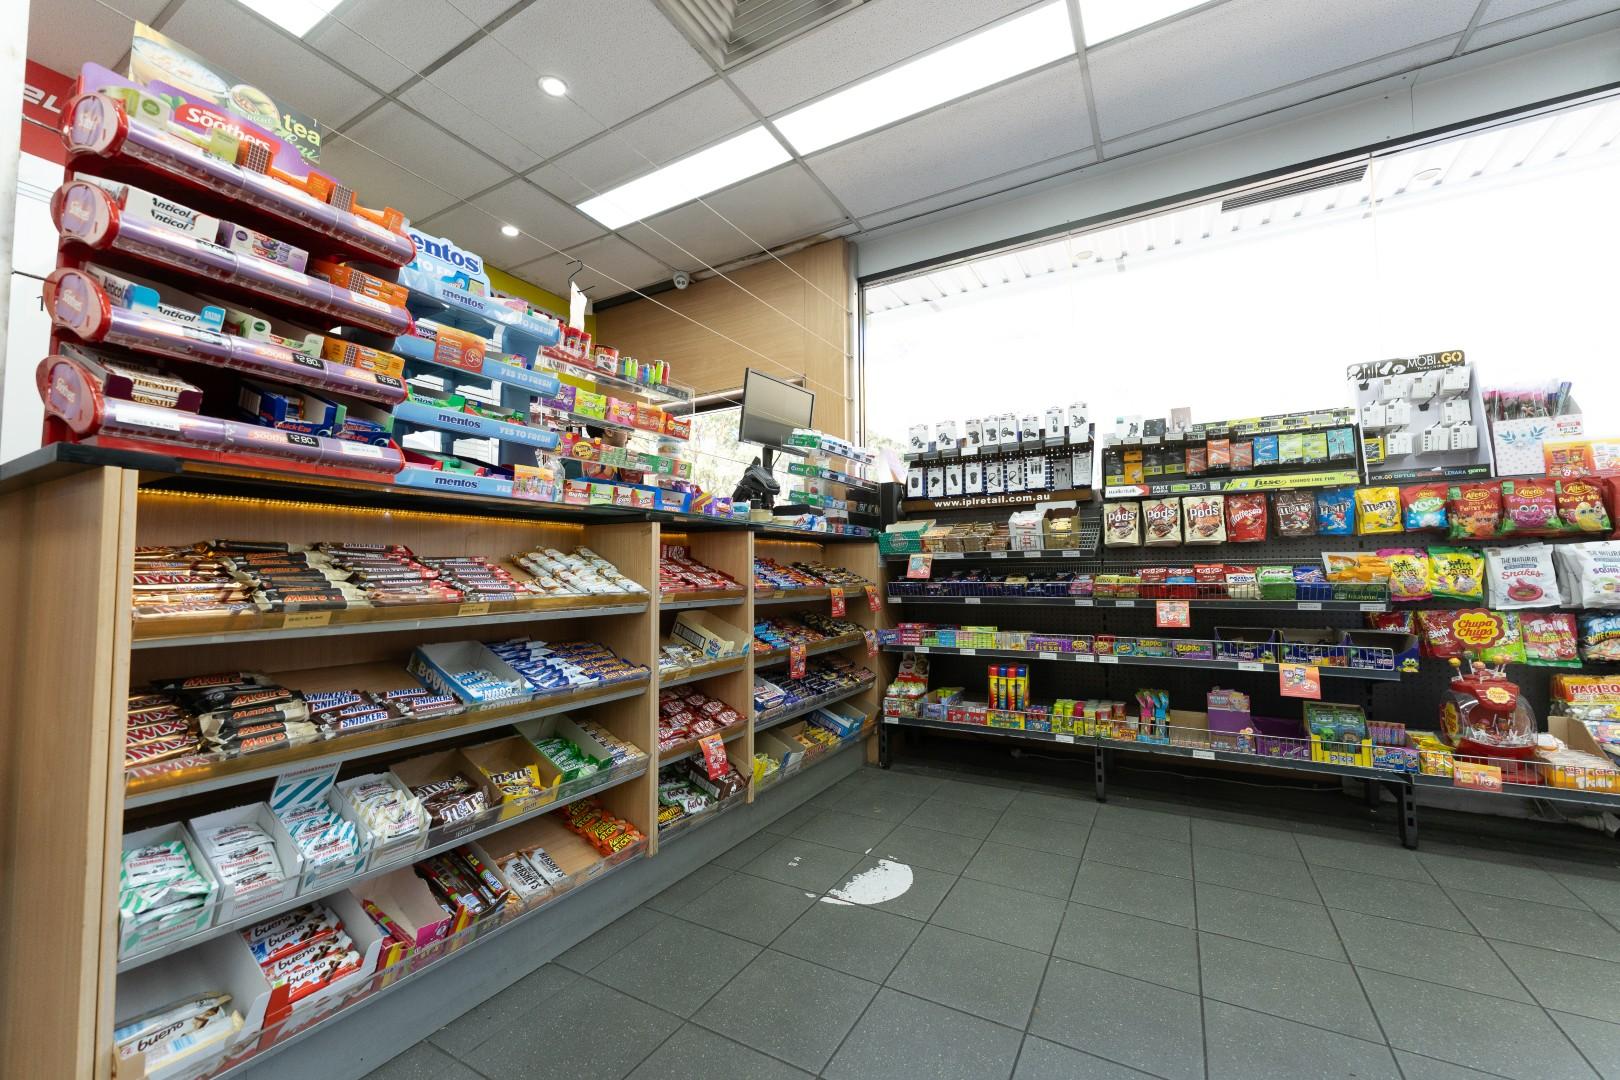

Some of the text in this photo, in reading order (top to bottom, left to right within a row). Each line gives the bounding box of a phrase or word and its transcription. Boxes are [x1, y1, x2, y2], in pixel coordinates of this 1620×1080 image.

[283, 114, 320, 147] tea
[410, 233, 480, 274] entos
[442, 286, 485, 310] mentos
[157, 305, 196, 323] Anticol
[438, 412, 482, 430] mentos
[434, 476, 478, 489] mentos
[1254, 478, 1283, 489] fuse
[934, 493, 1051, 509] www.iplretail.com.au
[1189, 506, 1220, 521] Pods
[1501, 568, 1544, 580] Snakes
[1458, 619, 1494, 630] Chupa
[1457, 628, 1493, 641] Chups
[1570, 684, 1620, 695] HARIBO
[413, 695, 454, 707] SNICKERS
[128, 707, 178, 728] WIX
[341, 712, 388, 729] SNICKERS
[687, 796, 704, 812] Aero
[538, 852, 567, 878] HERSHEY'S
[511, 862, 542, 890] HERSHEY'S
[254, 913, 292, 938] bueno
[268, 924, 305, 947] bueno
[278, 945, 316, 970] bueno
[287, 961, 326, 985] bueno
[137, 1020, 185, 1052] bueno
